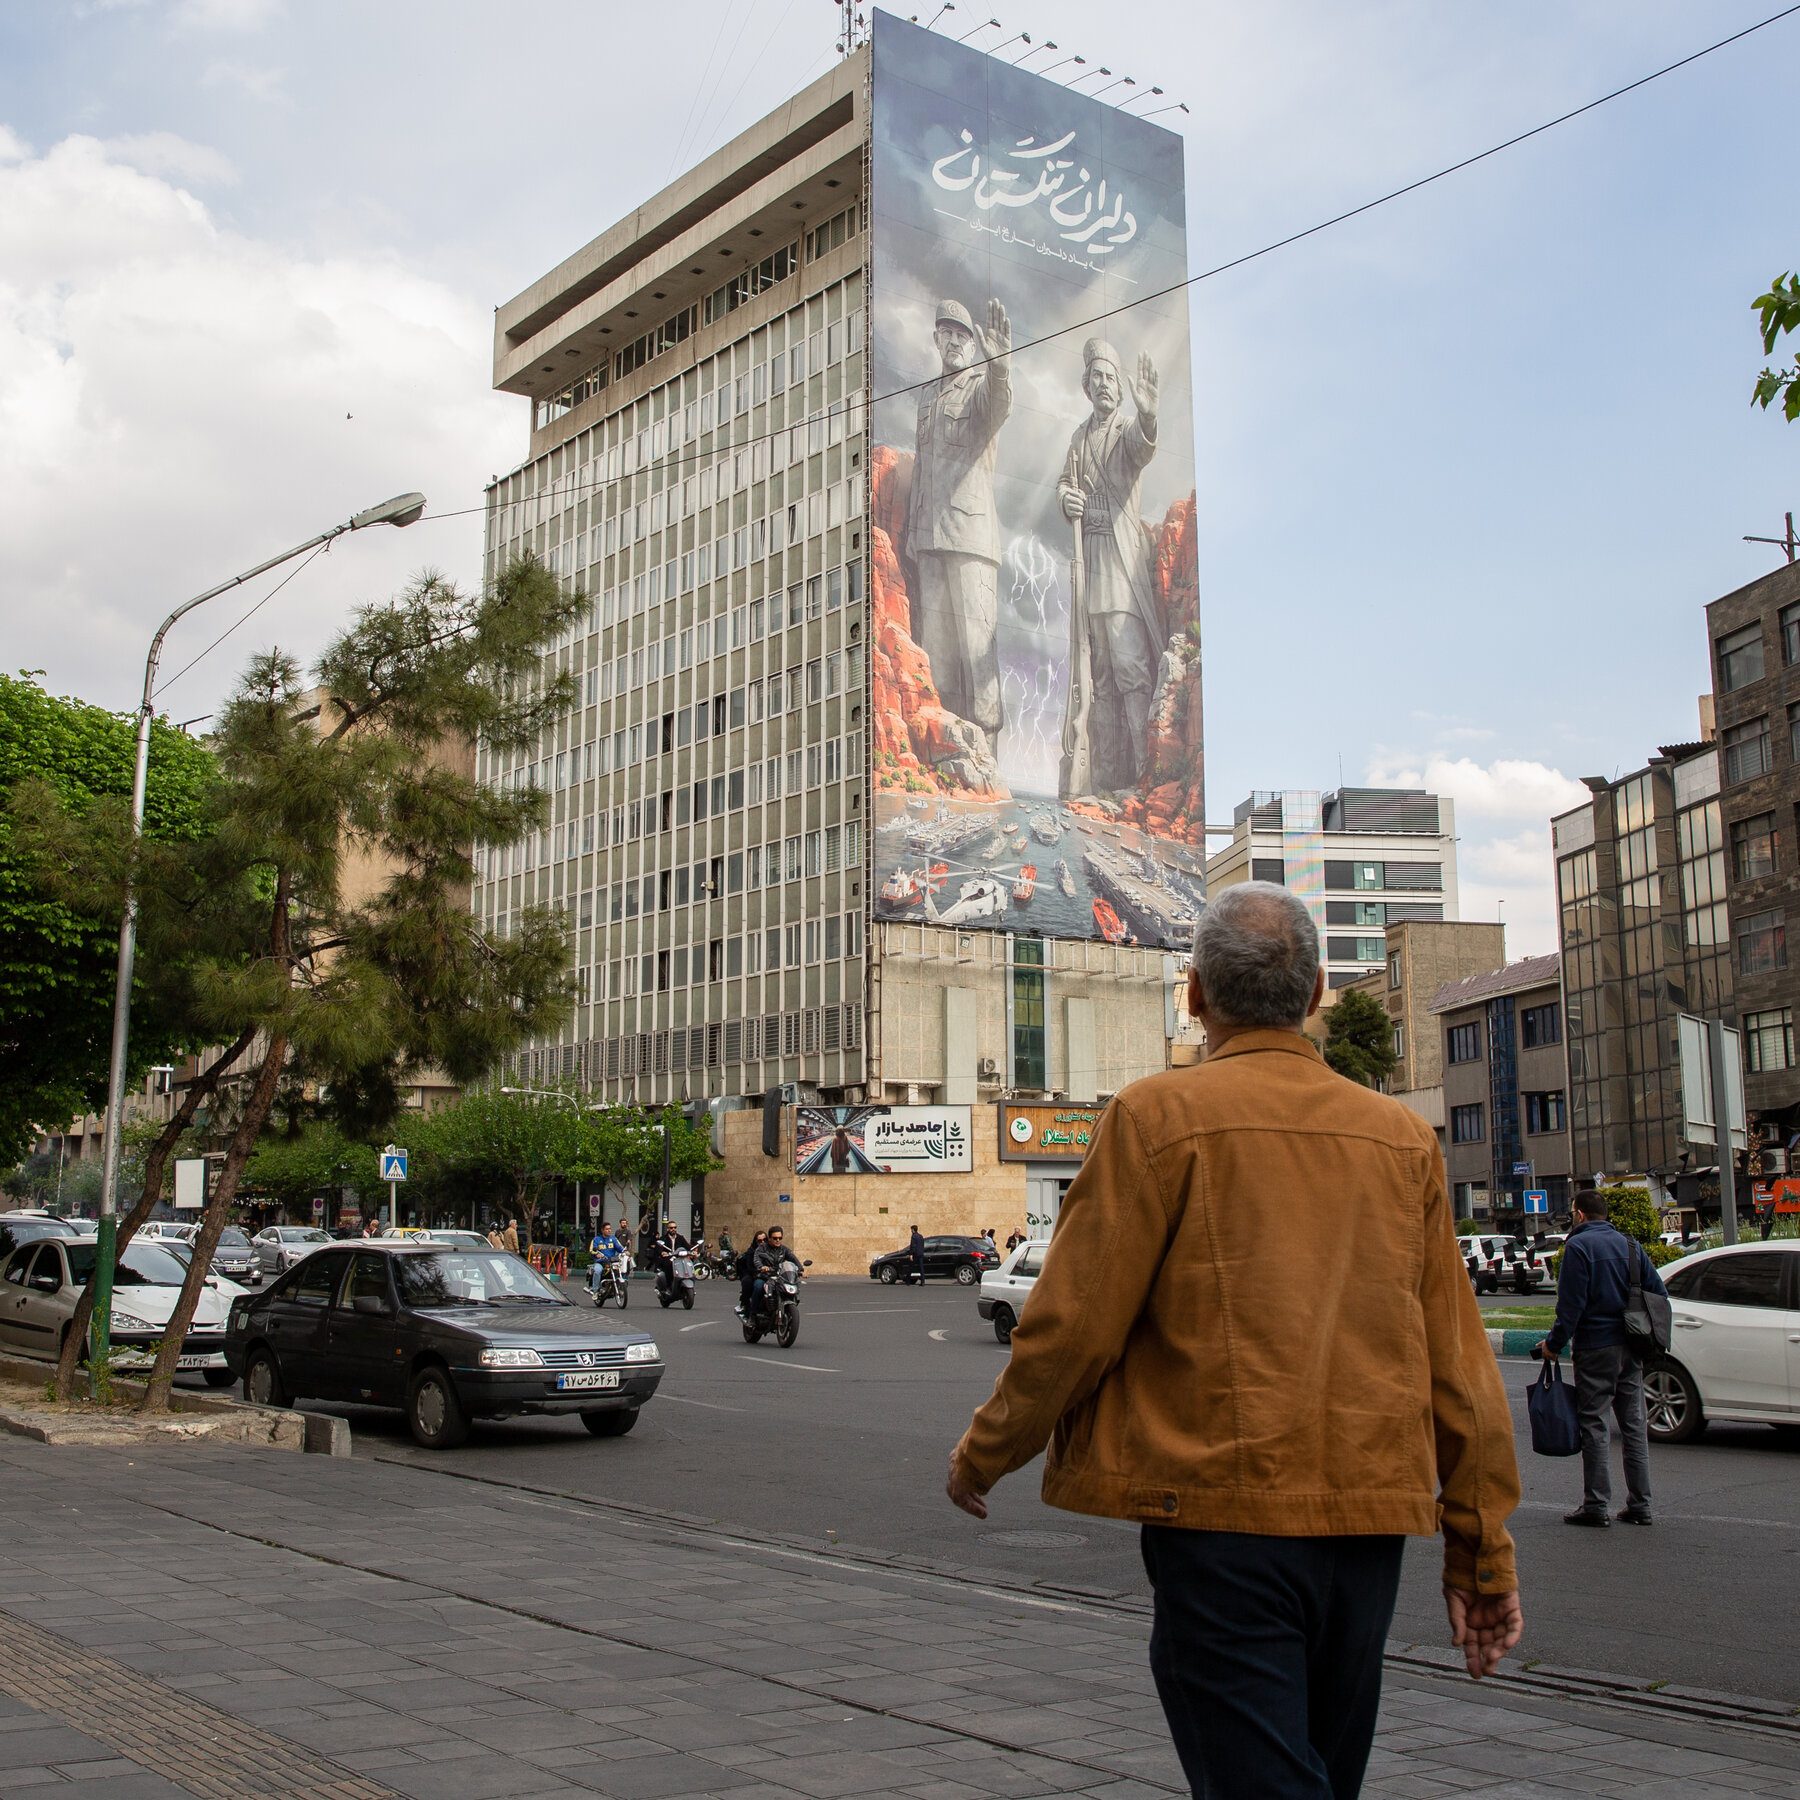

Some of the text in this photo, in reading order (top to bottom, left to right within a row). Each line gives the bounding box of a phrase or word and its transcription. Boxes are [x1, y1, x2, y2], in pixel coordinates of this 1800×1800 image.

[932, 128, 1137, 254] دلیران تنگستان
[969, 218, 1106, 276] به یاد دلیران تاریخ ایران
[875, 1121, 943, 1137] جاهد بازار
[1041, 1129, 1074, 1147] استقلال
